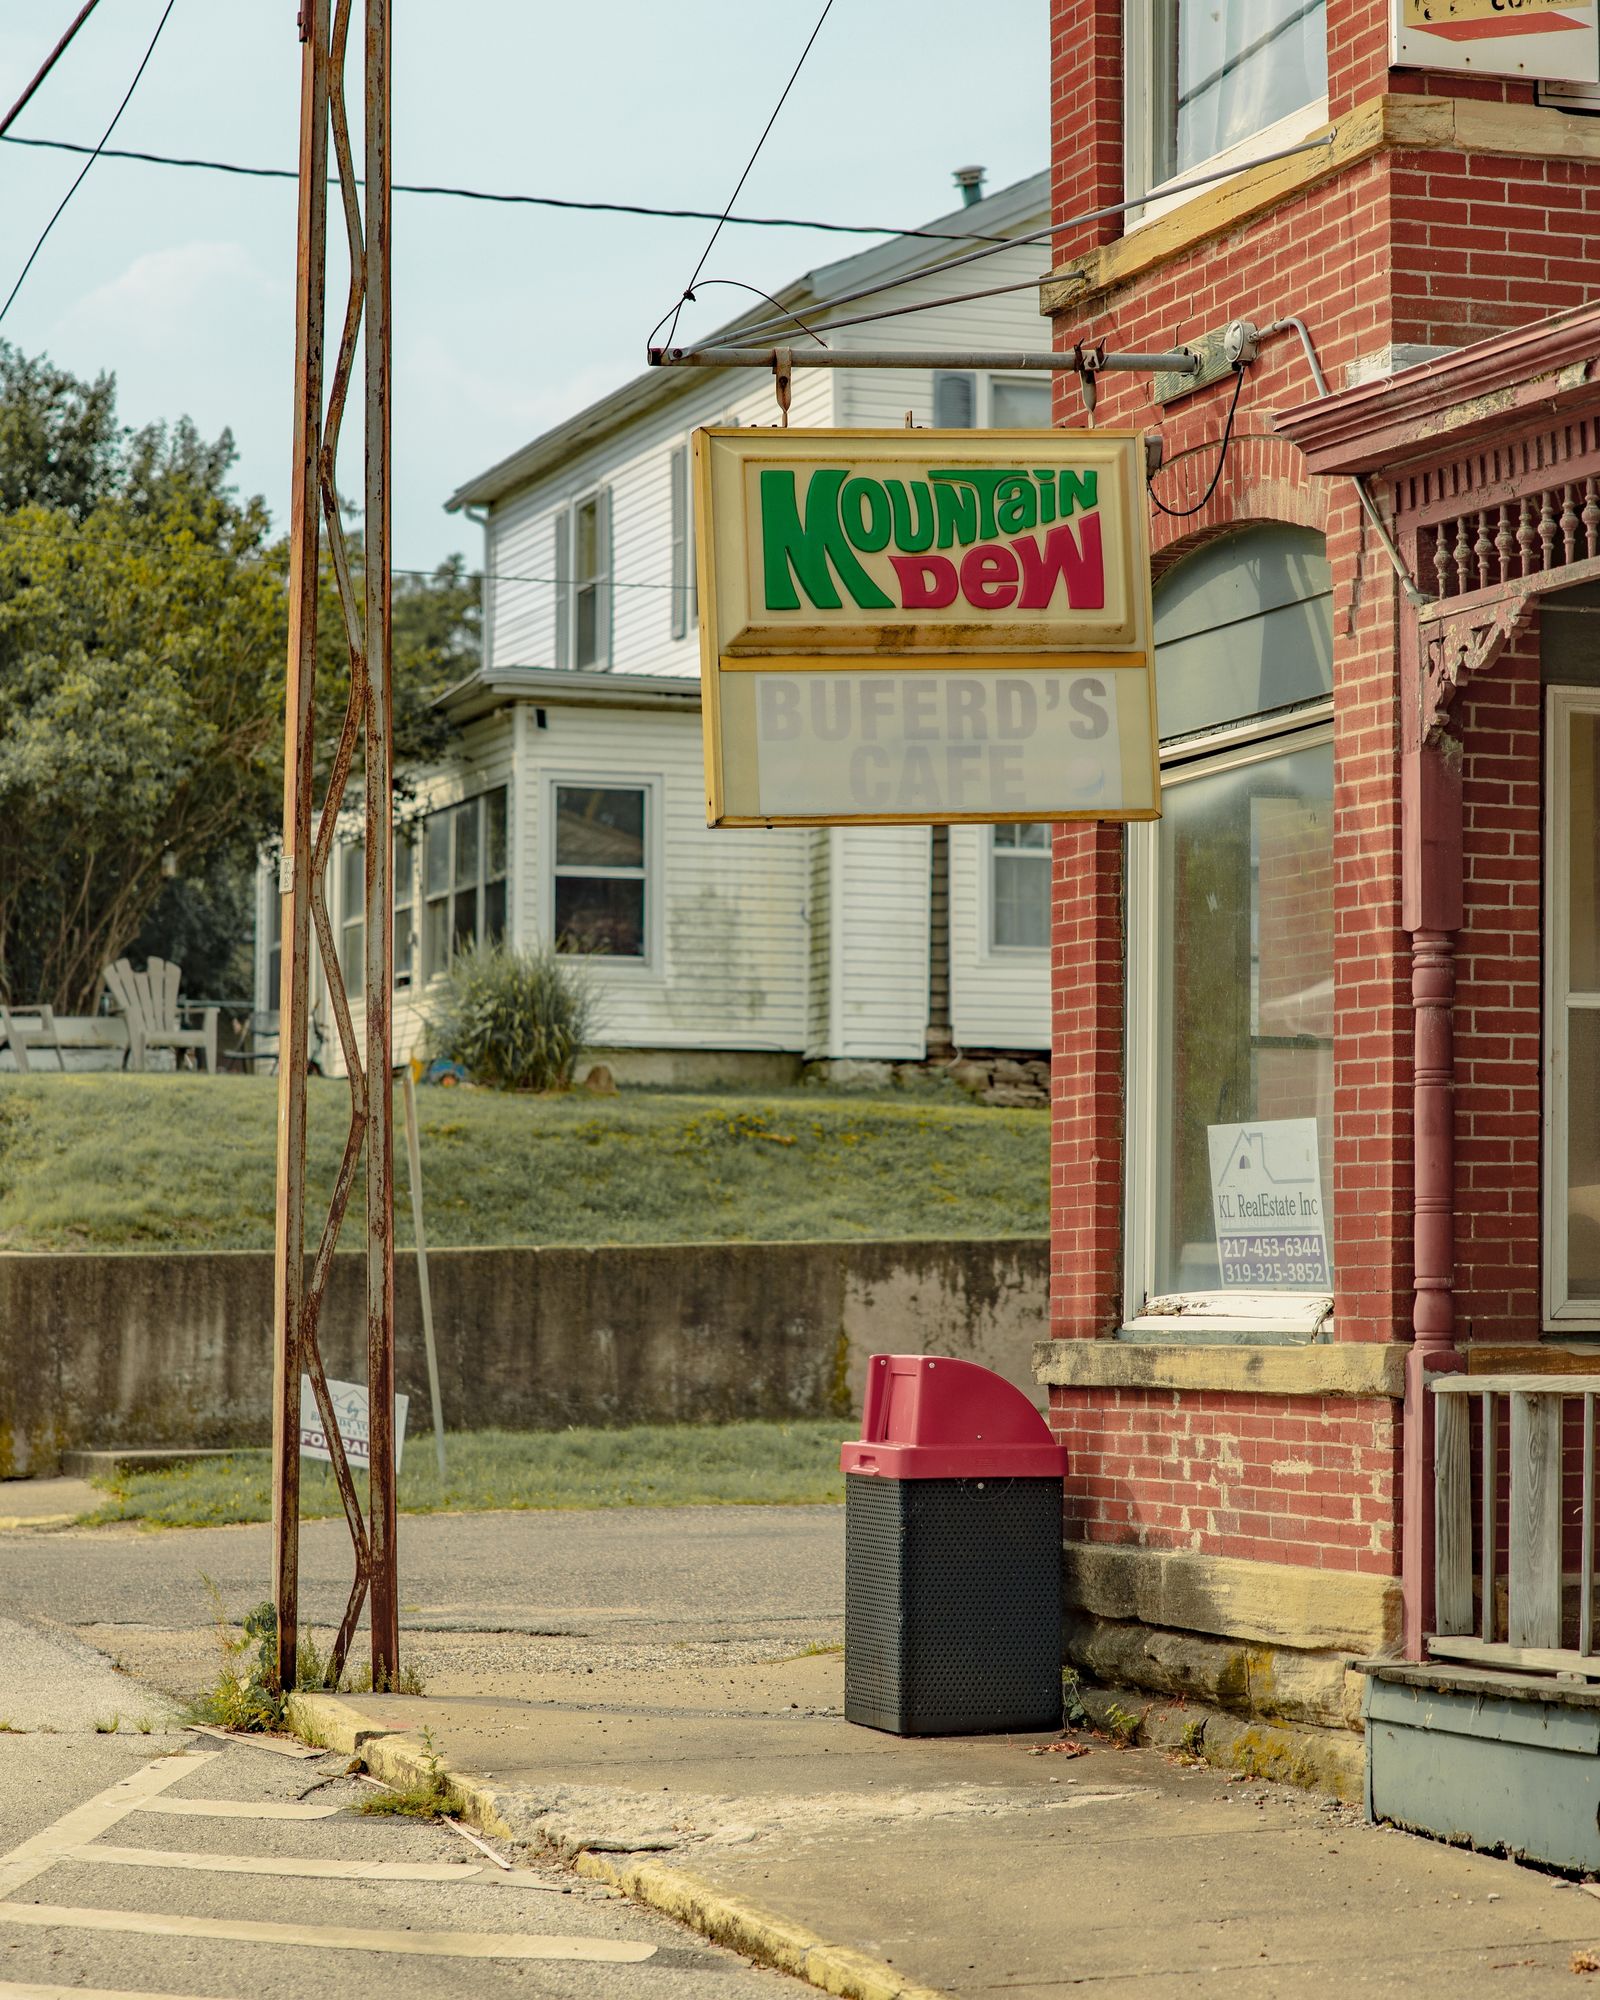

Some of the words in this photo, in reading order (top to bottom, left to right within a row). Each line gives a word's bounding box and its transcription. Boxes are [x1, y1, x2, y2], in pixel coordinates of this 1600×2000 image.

[760, 677, 1109, 741] BUFERD'S
[849, 745, 1025, 806] CAFE
[1218, 1195, 1235, 1218] KL
[1238, 1193, 1296, 1217] RealEstate
[1299, 1192, 1318, 1215] Inc
[1223, 1237, 1321, 1258] 217-453-6344
[1226, 1263, 1324, 1282] 319-325-3852
[301, 1431, 328, 1448] FO
[342, 1439, 369, 1455] SAL
